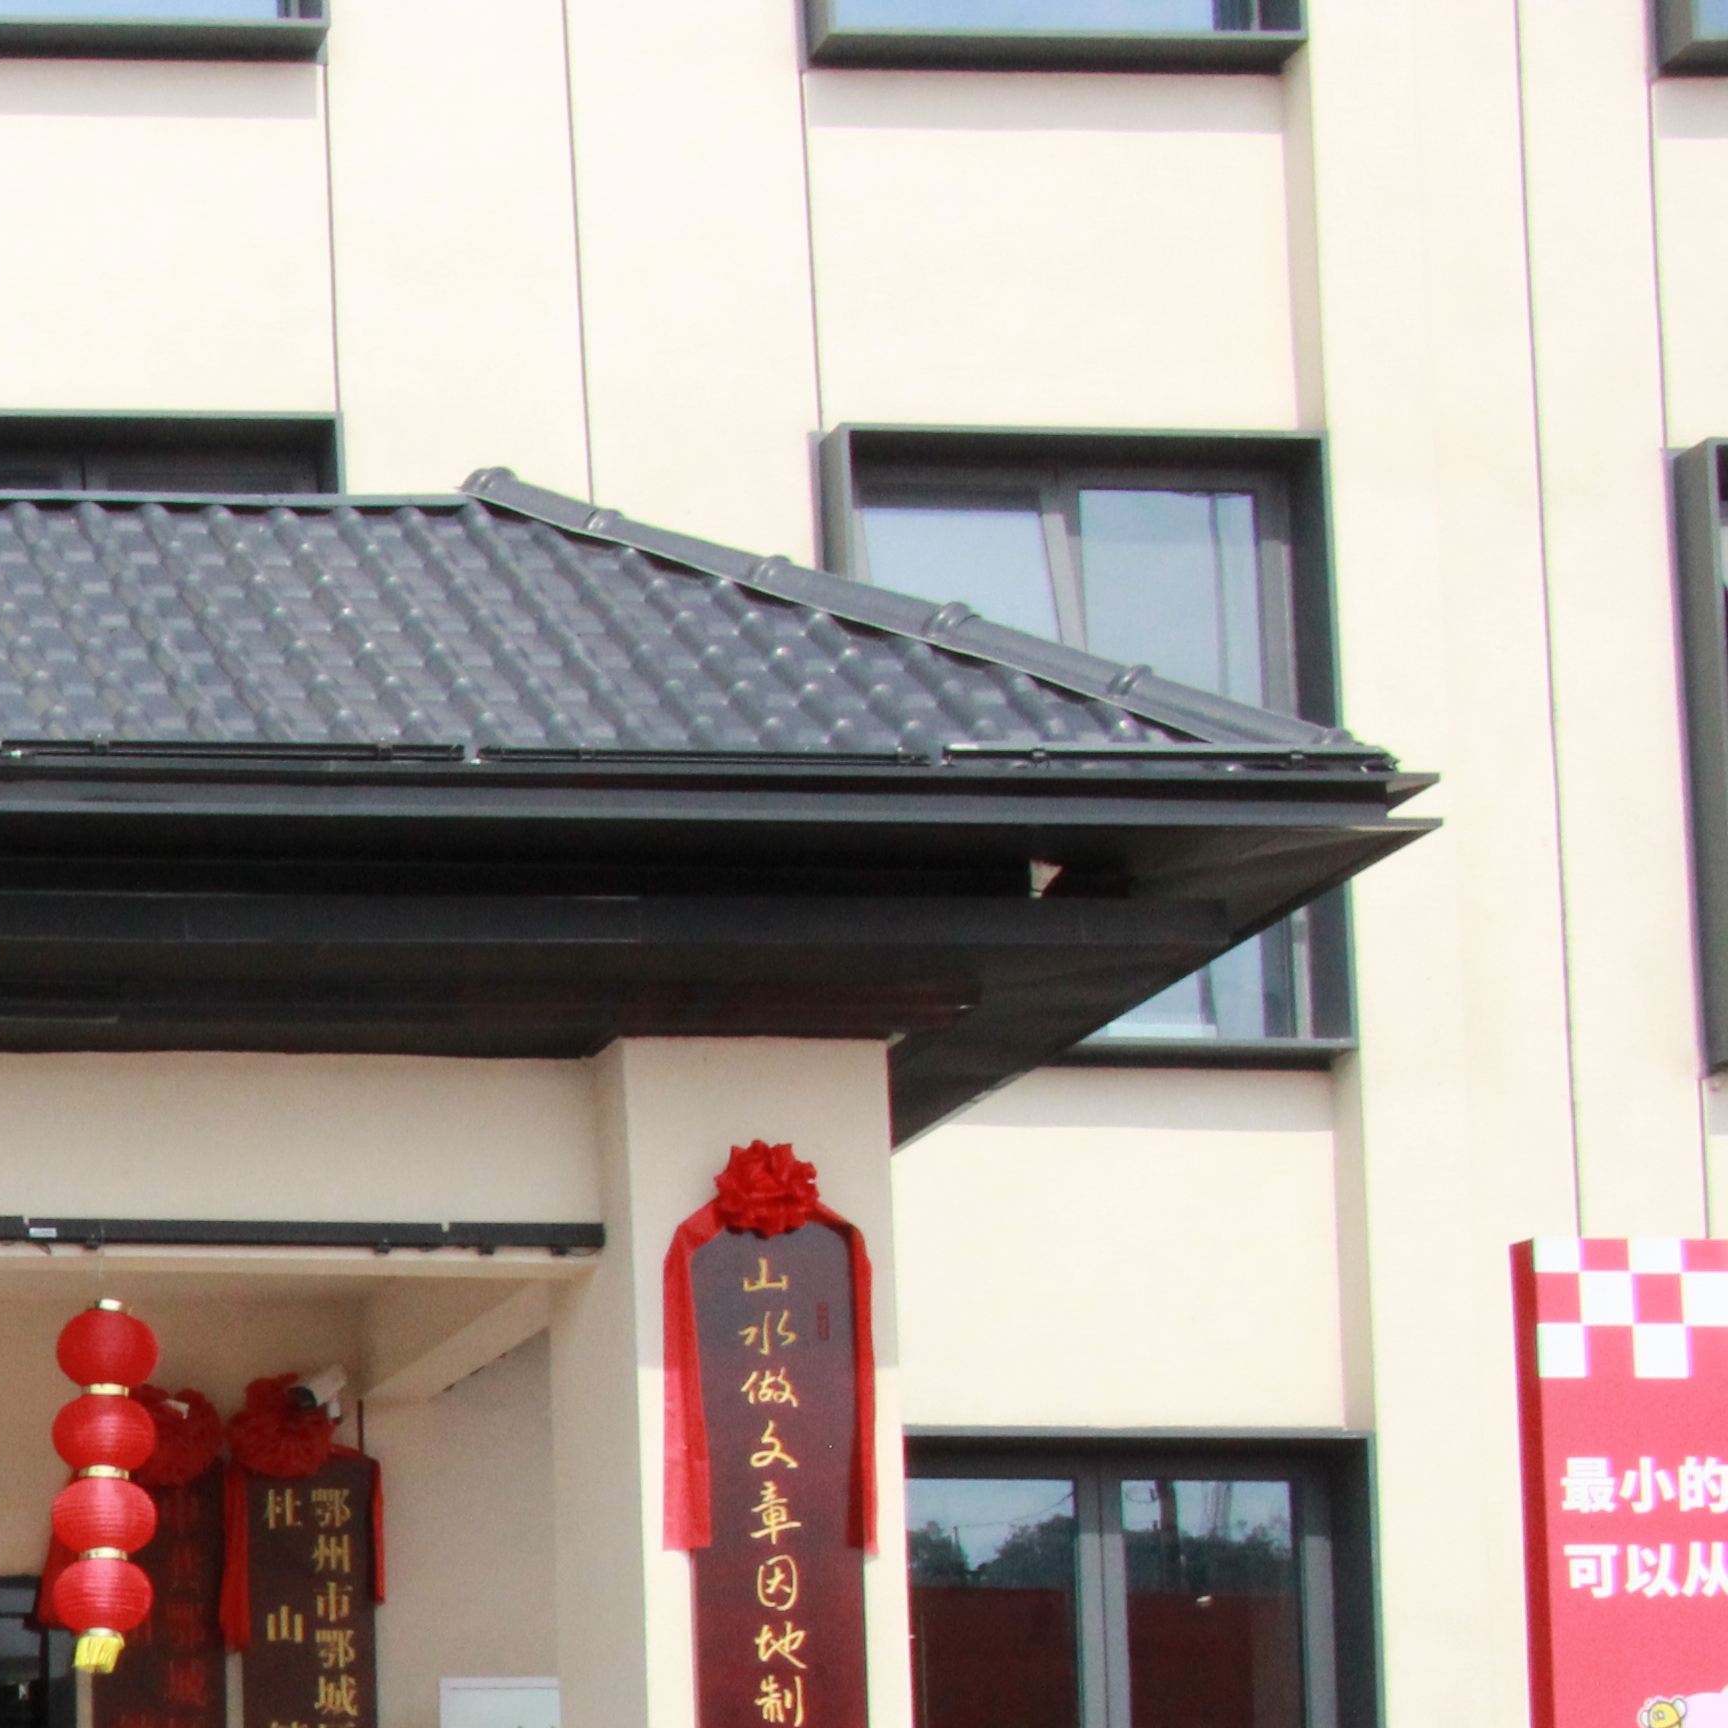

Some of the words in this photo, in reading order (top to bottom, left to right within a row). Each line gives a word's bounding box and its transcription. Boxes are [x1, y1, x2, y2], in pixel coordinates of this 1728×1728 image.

[1560, 1456, 1728, 1514] 最小的
[1563, 1541, 1728, 1599] 可以从
